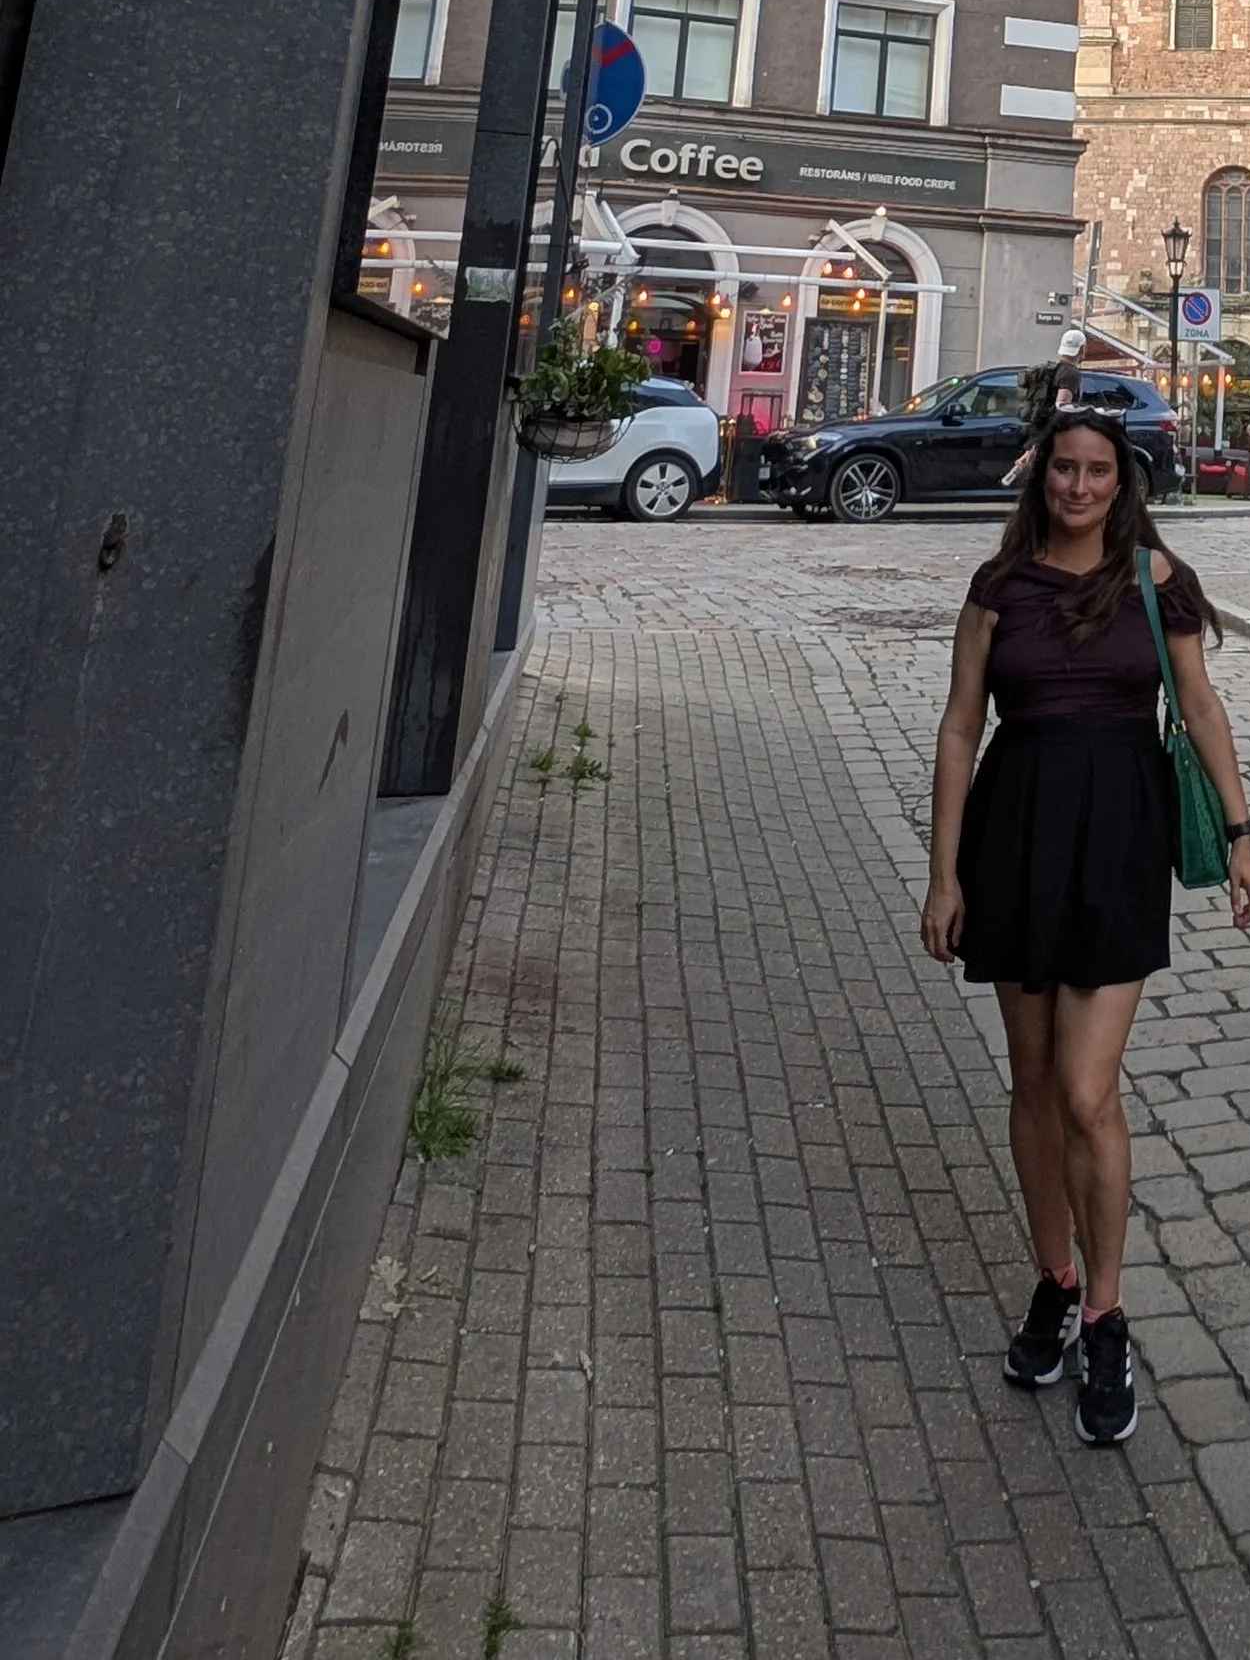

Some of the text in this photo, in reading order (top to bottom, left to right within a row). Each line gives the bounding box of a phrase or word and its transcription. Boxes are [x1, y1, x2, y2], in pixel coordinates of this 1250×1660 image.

[620, 139, 764, 181] Coffee
[868, 173, 893, 185] WINE
[895, 176, 922, 187] FOOD
[924, 178, 956, 190] CREPE
